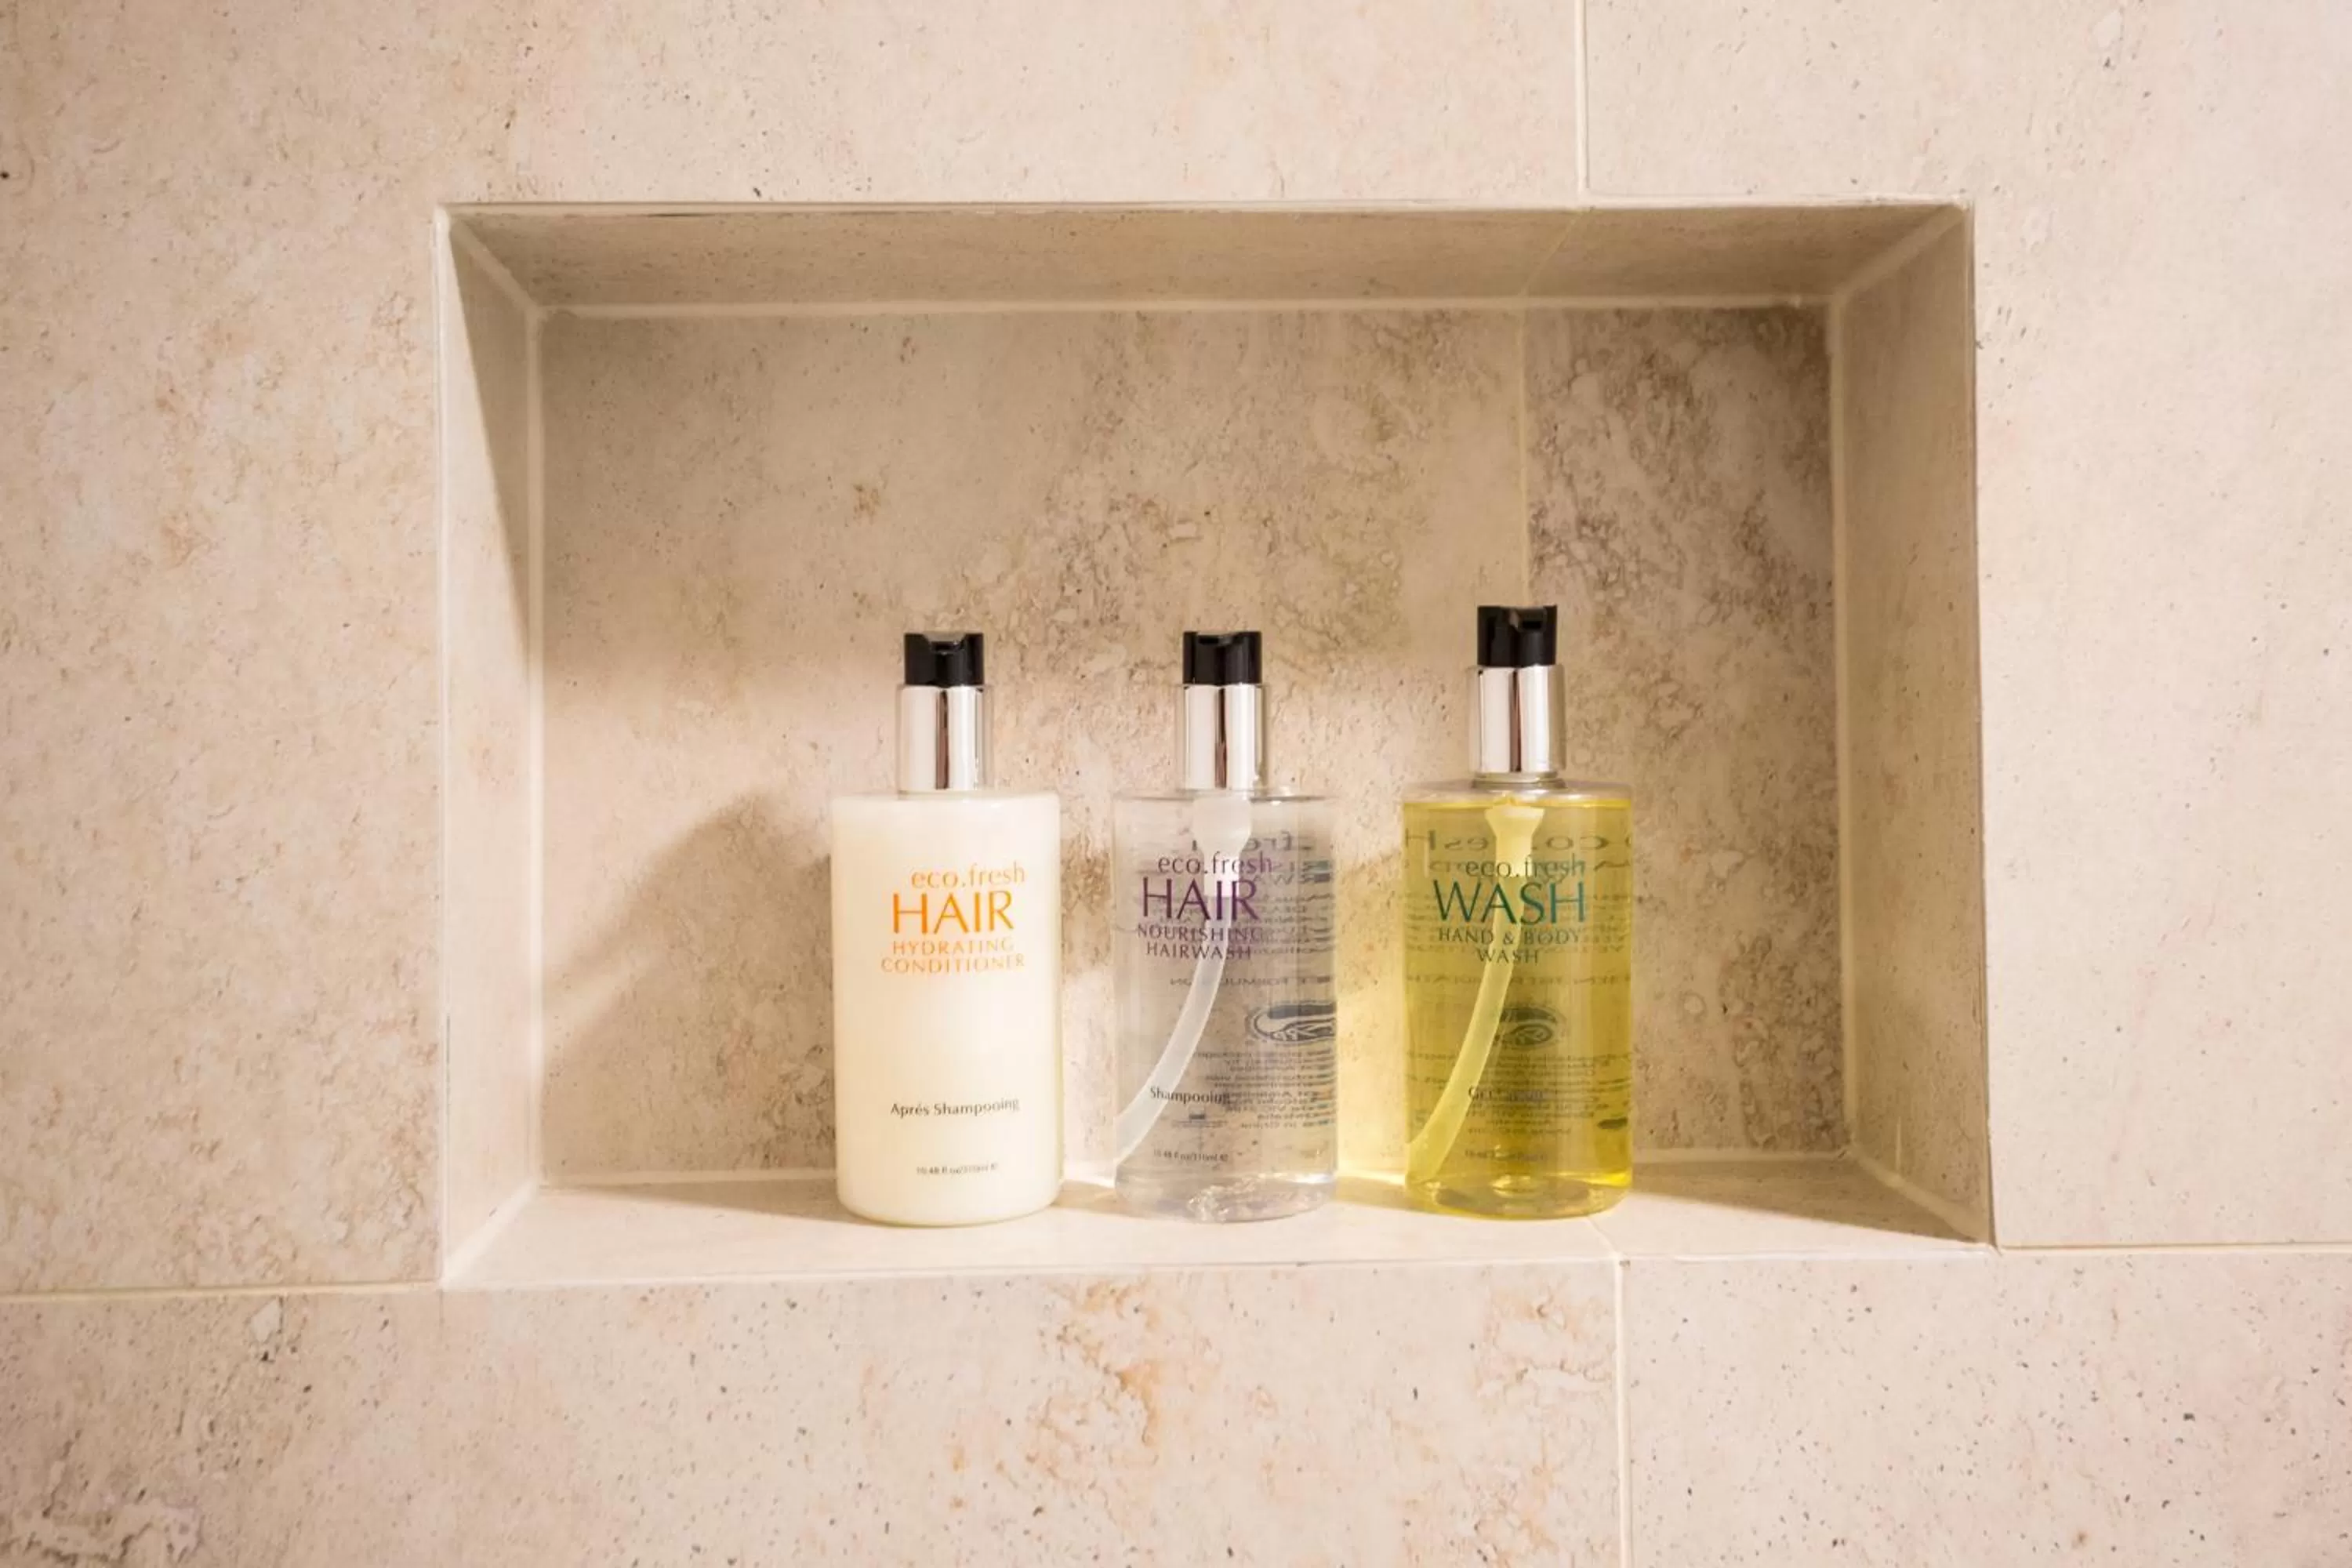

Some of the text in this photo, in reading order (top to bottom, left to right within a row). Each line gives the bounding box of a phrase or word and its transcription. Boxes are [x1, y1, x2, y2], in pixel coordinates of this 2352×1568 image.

[1158, 851, 1272, 874] eco.fresh
[1465, 853, 1585, 878] eco.fresh
[911, 860, 1025, 888] eco.fresh
[1142, 877, 1260, 920] HAIR
[1433, 879, 1585, 925] WASH
[893, 890, 1014, 935] HAIR
[893, 937, 1014, 956] HYDRATING
[1439, 927, 1494, 945] HAND
[1523, 928, 1581, 945] BODY
[1147, 943, 1251, 960] HAIRWASH
[1476, 949, 1538, 964] WASH
[880, 953, 1025, 974] CONDITIONER
[890, 1098, 1019, 1118] Aprés Shampooing
